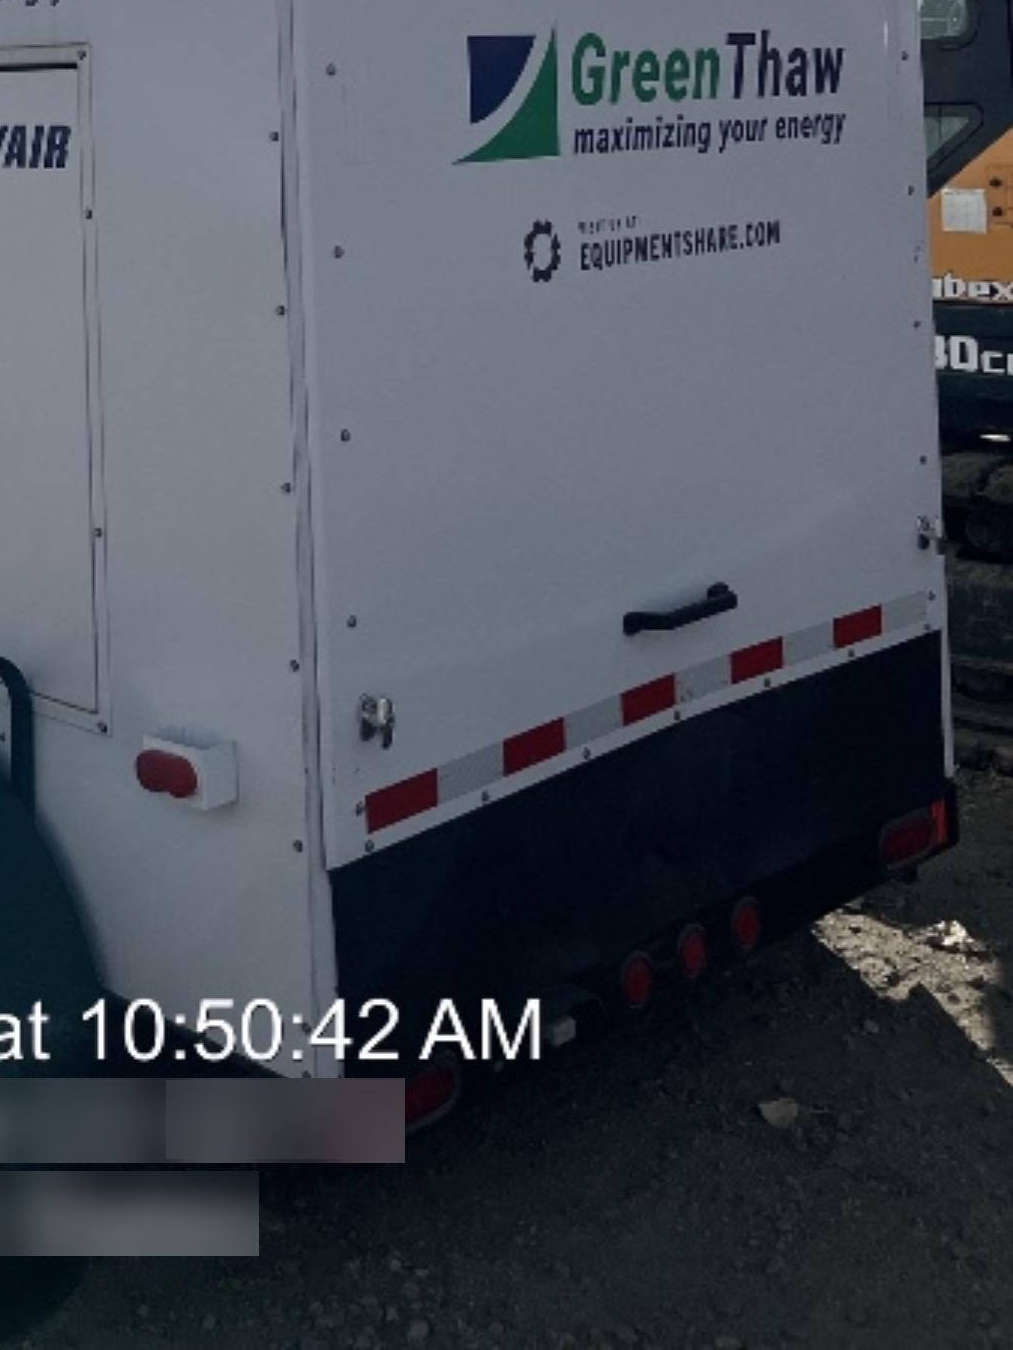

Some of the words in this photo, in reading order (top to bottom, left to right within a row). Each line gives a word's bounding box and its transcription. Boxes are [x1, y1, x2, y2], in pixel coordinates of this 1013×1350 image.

[574, 114, 711, 154] maximizing
[718, 116, 768, 153] your
[775, 113, 847, 145] energy
[580, 219, 781, 271] EQUIPMENTSHARE.COM
